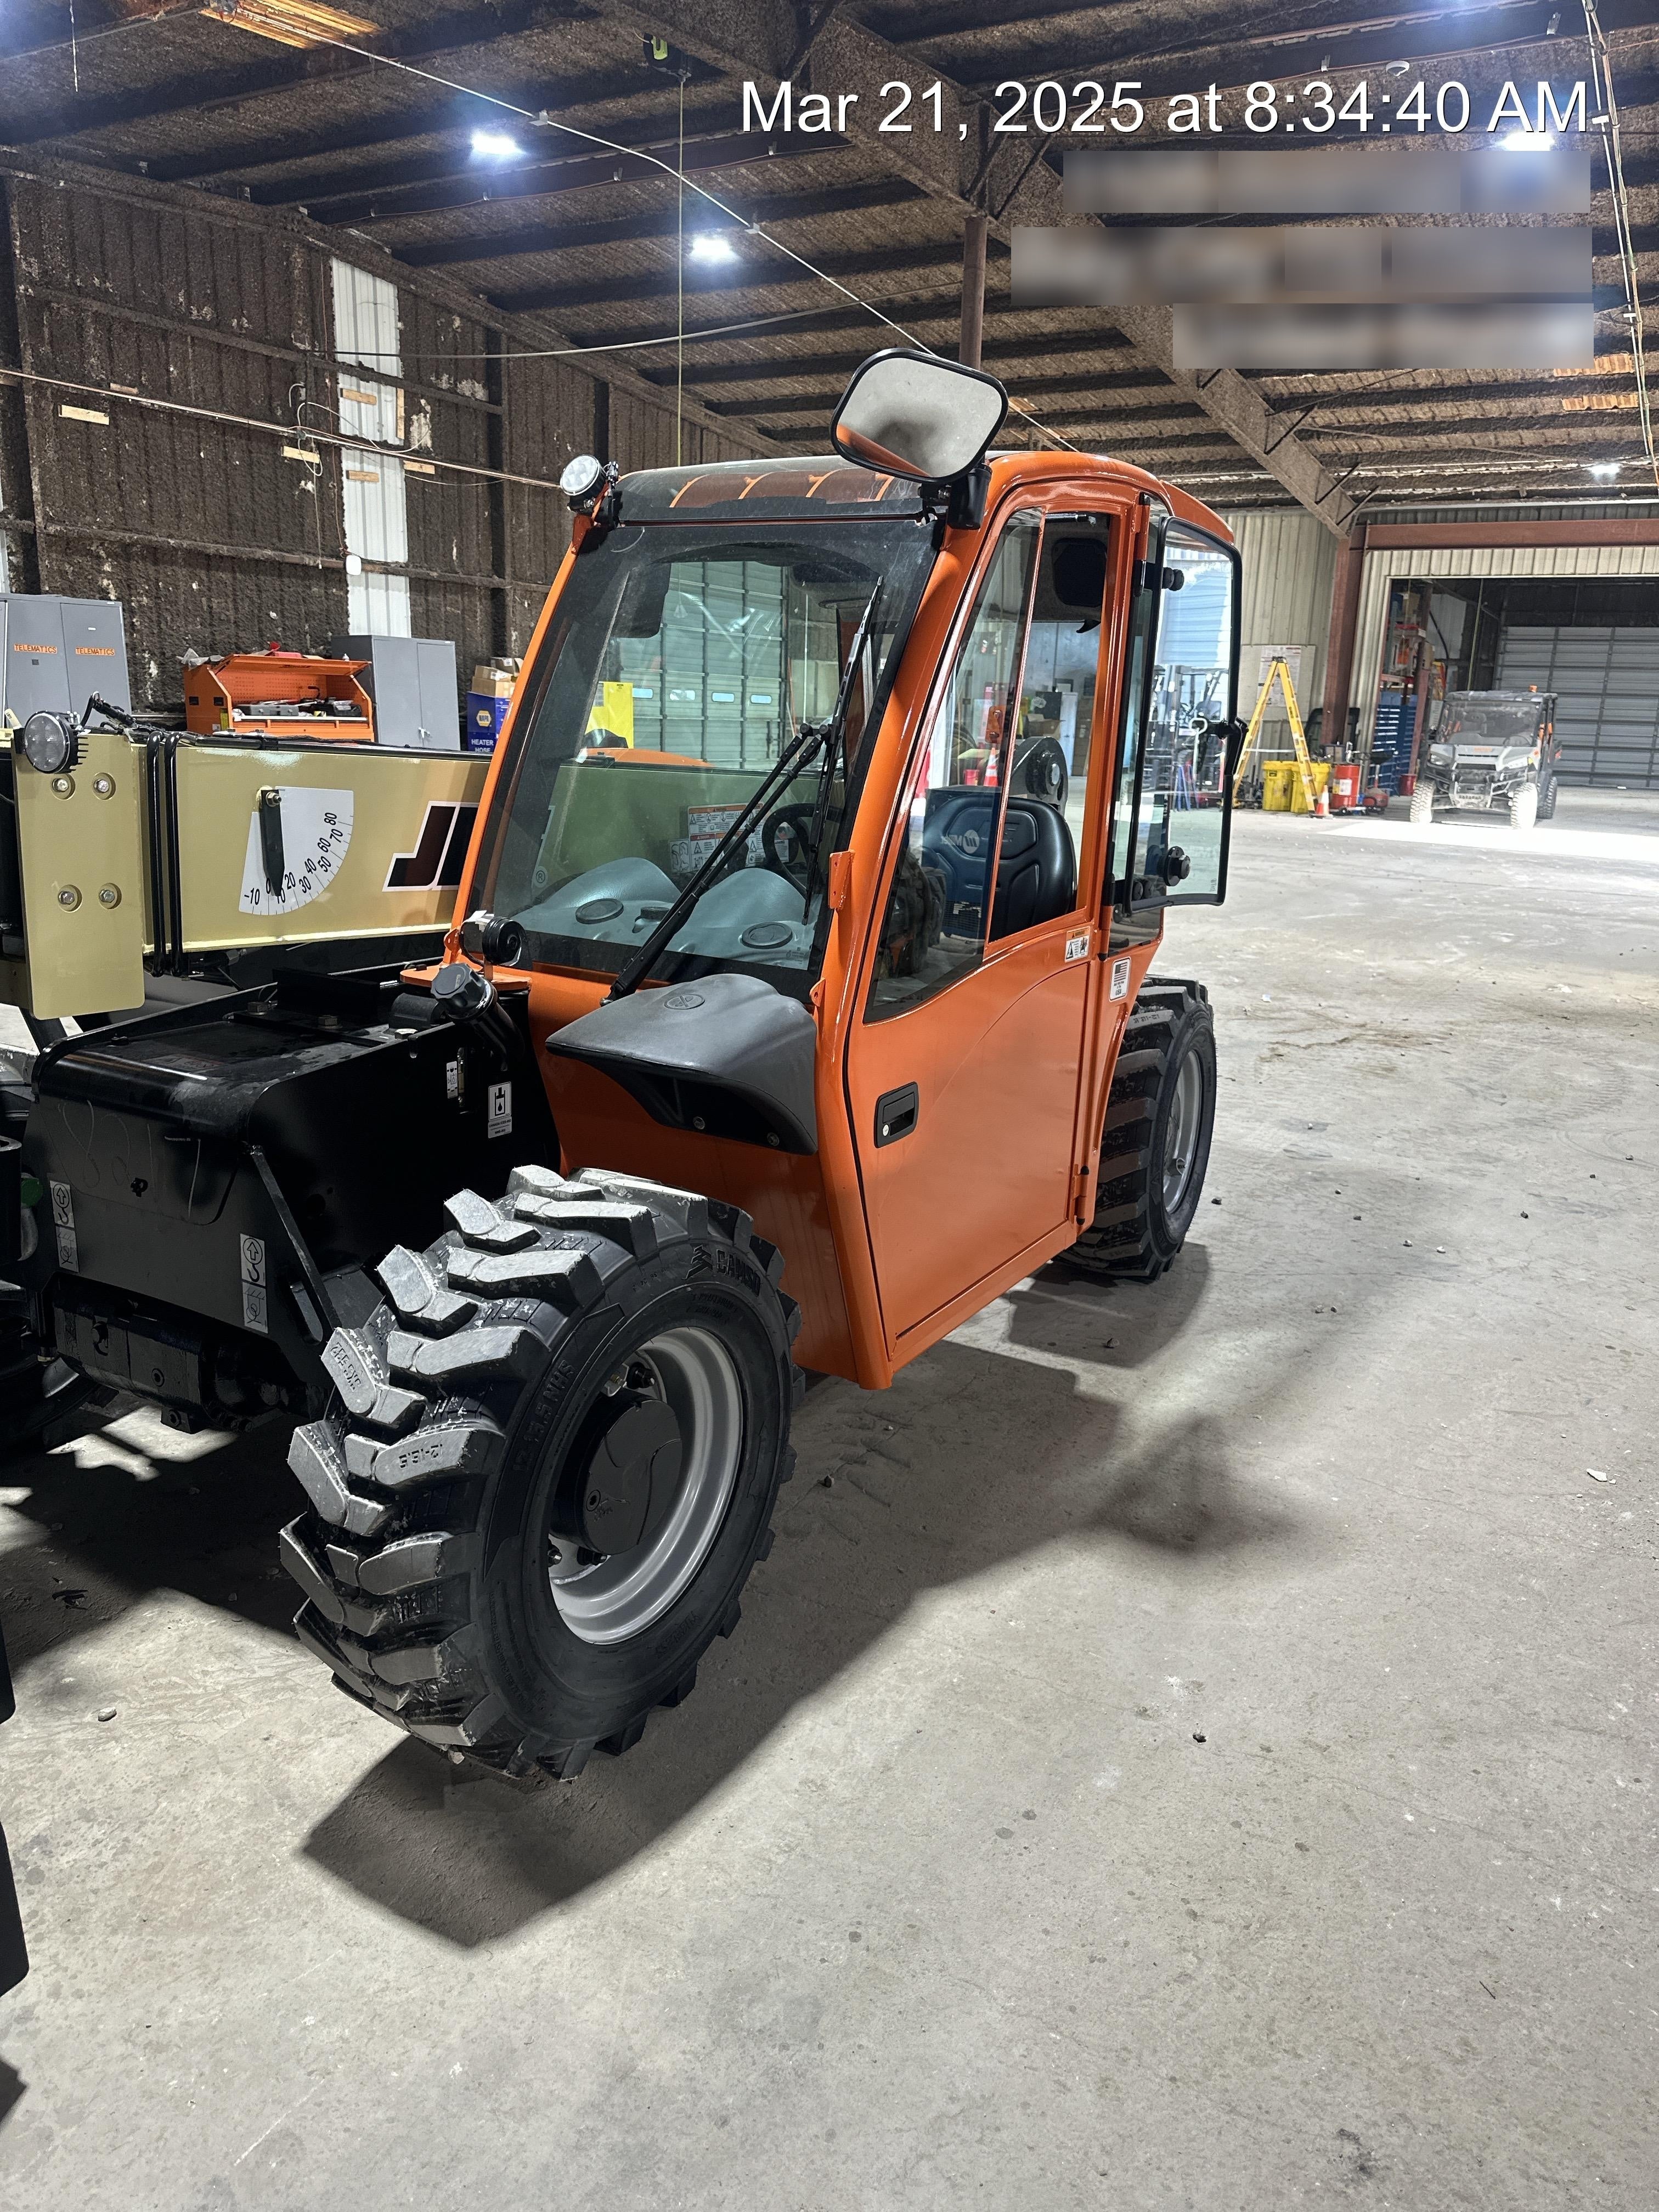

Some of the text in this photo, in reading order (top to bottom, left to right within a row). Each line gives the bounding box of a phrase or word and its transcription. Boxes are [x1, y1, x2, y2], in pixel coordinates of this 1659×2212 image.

[15, 644, 57, 653] TELEMATICS
[324, 812, 337, 826] 80
[330, 828, 343, 843] 70
[317, 837, 331, 853] 60
[304, 858, 317, 874] 40
[317, 856, 331, 873] 50
[266, 877, 271, 894] 0
[284, 872, 296, 890] 20
[298, 876, 312, 894] 30
[244, 887, 261, 905] -10
[716, 1248, 761, 1297] CAMSO
